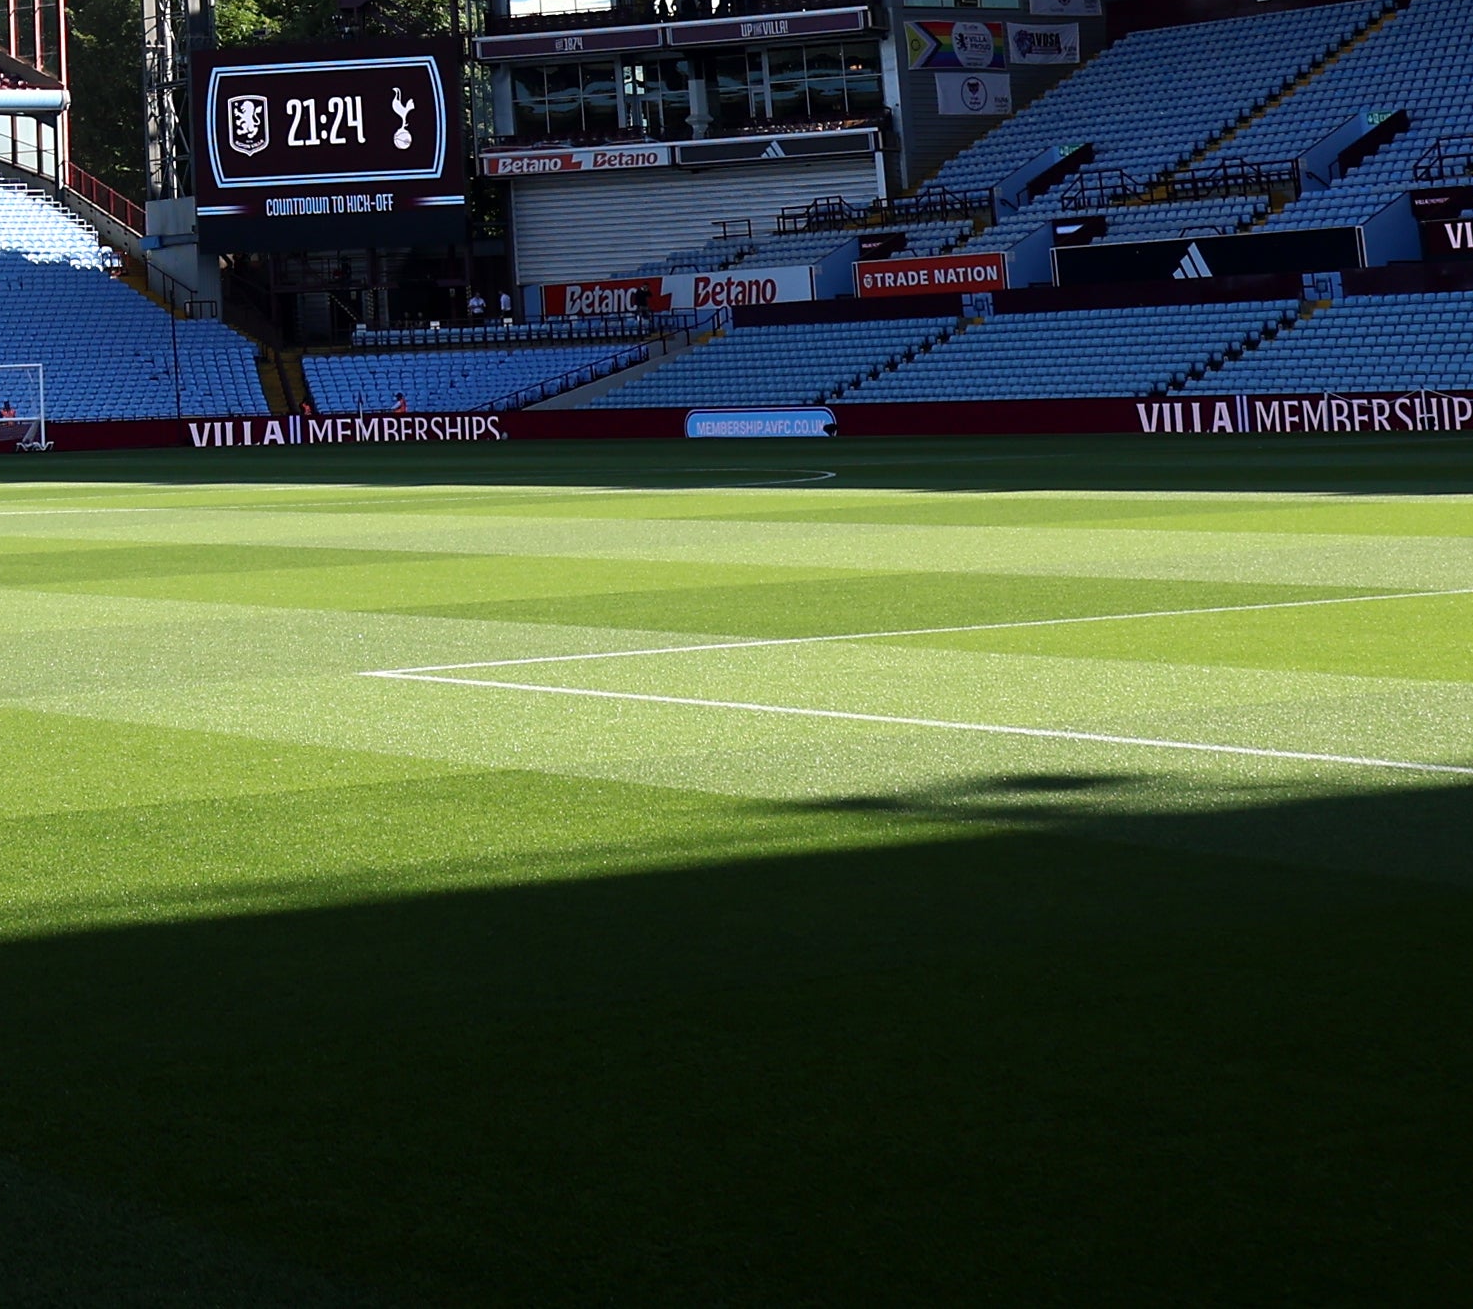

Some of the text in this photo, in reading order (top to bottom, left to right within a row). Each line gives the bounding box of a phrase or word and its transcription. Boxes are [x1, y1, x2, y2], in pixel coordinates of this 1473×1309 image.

[740, 24, 753, 37] UP
[564, 36, 584, 51] 1874
[285, 95, 366, 147] 21:24
[498, 152, 658, 173] Betano Betano
[265, 193, 393, 216] COUNTDOWN TO KICK-OFF
[874, 265, 998, 287] TRADE NATION
[693, 276, 778, 308] Betano
[696, 418, 825, 436] MEMBERSHIP.AVFC.CO.UK
[1136, 401, 1234, 433] VILLA
[188, 416, 501, 447] VILLA MEMBERSHIPS
